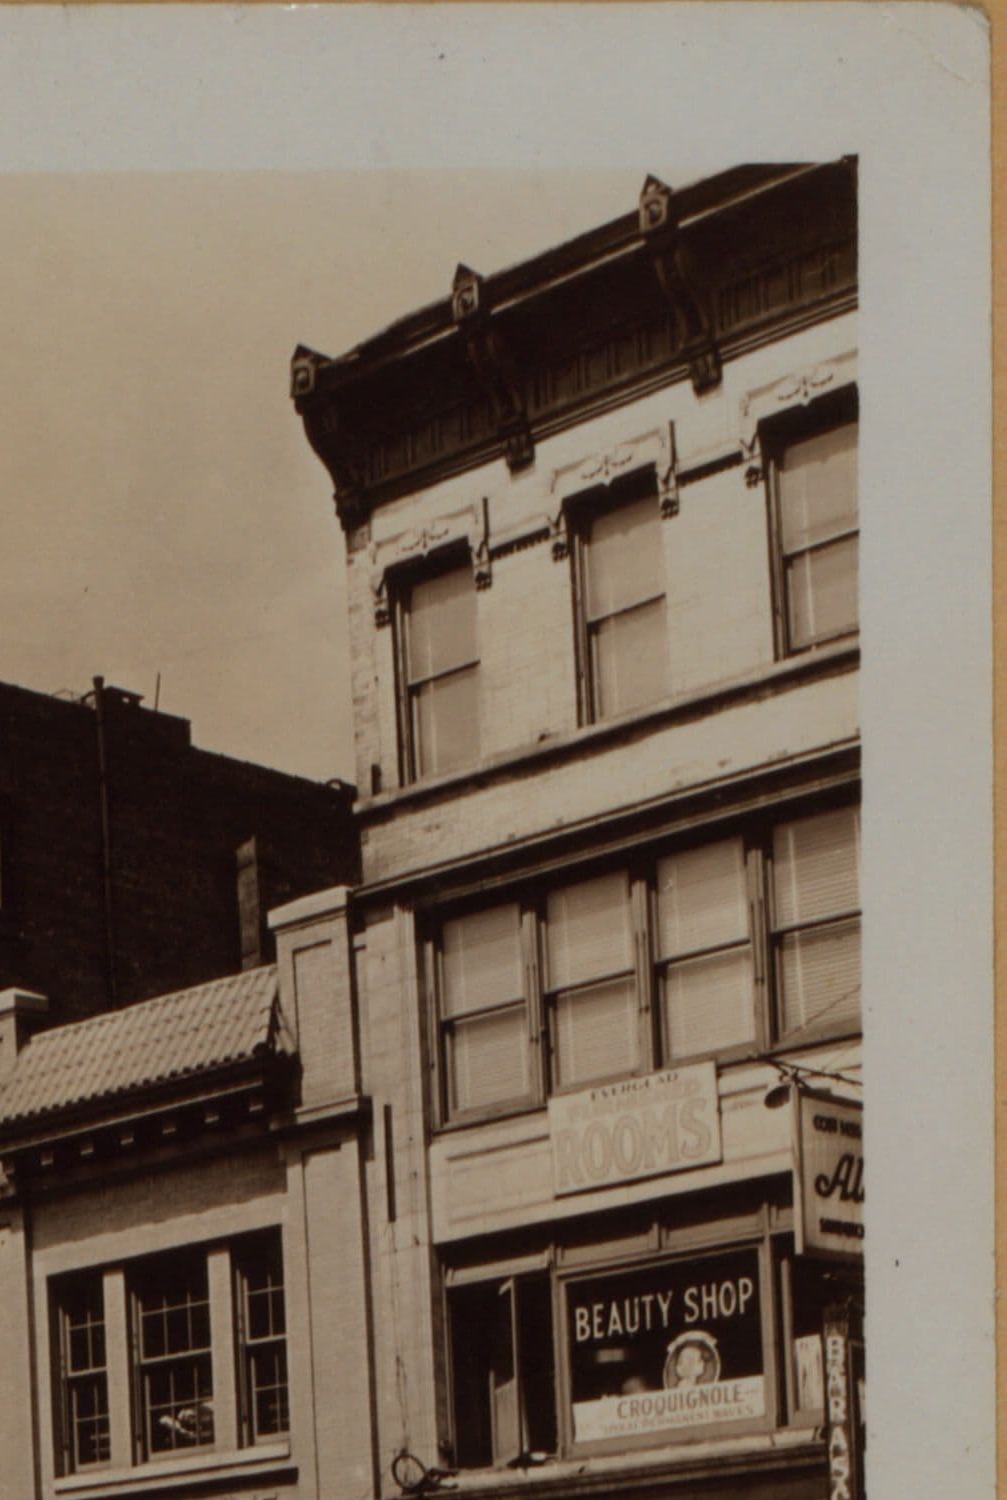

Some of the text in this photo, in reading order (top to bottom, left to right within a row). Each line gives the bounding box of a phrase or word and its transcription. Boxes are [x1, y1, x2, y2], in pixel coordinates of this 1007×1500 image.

[555, 1097, 712, 1187] ROOMS
[814, 1153, 864, 1204] Al
[575, 1277, 754, 1342] BEAUTY SHOP
[616, 1383, 745, 1420] CROQUIGNOLE
